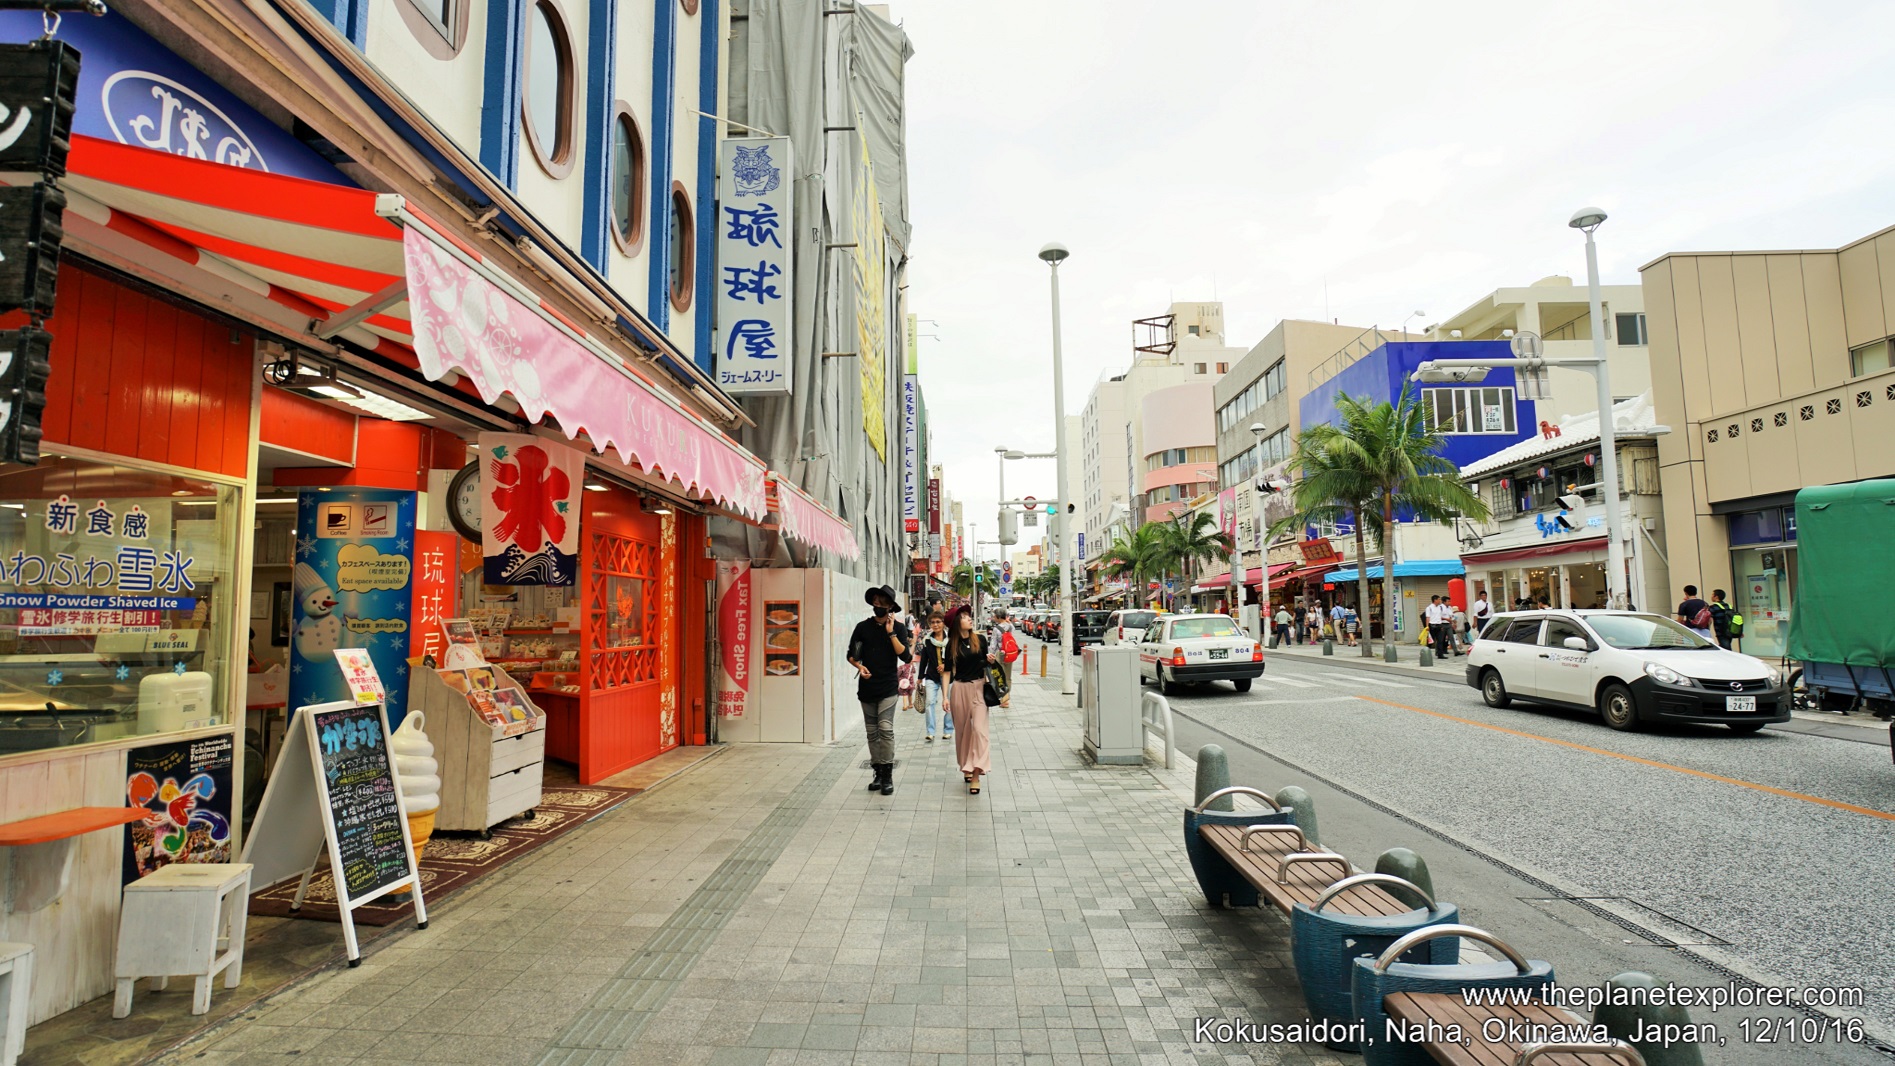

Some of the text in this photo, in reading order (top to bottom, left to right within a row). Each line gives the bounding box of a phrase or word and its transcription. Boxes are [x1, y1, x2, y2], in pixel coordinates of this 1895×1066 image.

[724, 202, 783, 361] 琉球屋
[721, 370, 783, 384] ジェームス・リー
[627, 392, 699, 458] KUKURU
[462, 496, 469, 504] 9
[465, 508, 472, 516] 8
[47, 502, 148, 538] 新食感
[47, 595, 105, 607] Powder
[108, 597, 158, 609] Shaved
[160, 599, 178, 608] Ice
[153, 641, 171, 649] BLUE
[1733, 702, 1754, 711] 24-77
[190, 750, 219, 762] Festival
